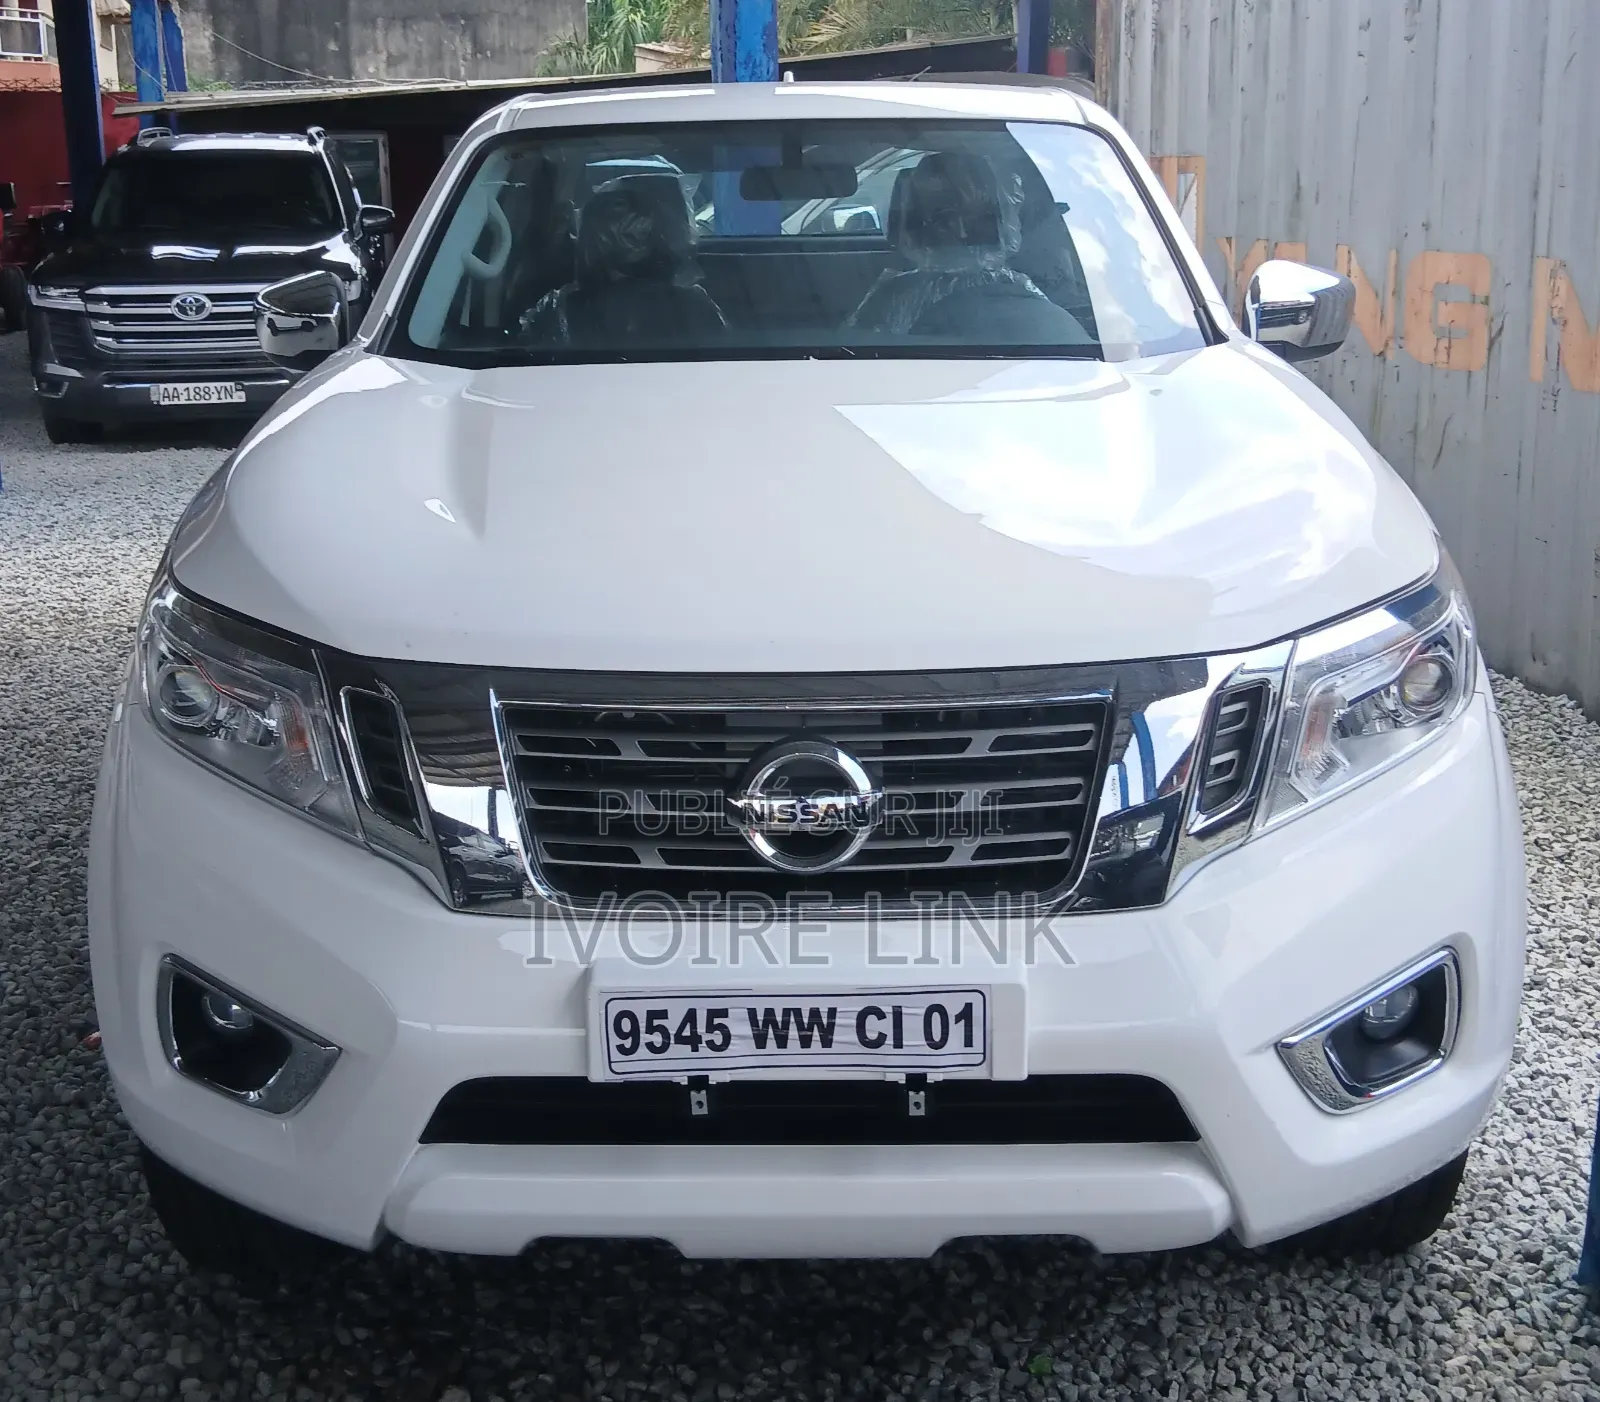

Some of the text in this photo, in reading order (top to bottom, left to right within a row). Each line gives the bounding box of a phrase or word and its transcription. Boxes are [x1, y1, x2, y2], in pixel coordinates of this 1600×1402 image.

[1216, 236, 1491, 372] YNG
[743, 802, 868, 823] NISSAN
[613, 1002, 975, 1056] 9545 WW CI 01
